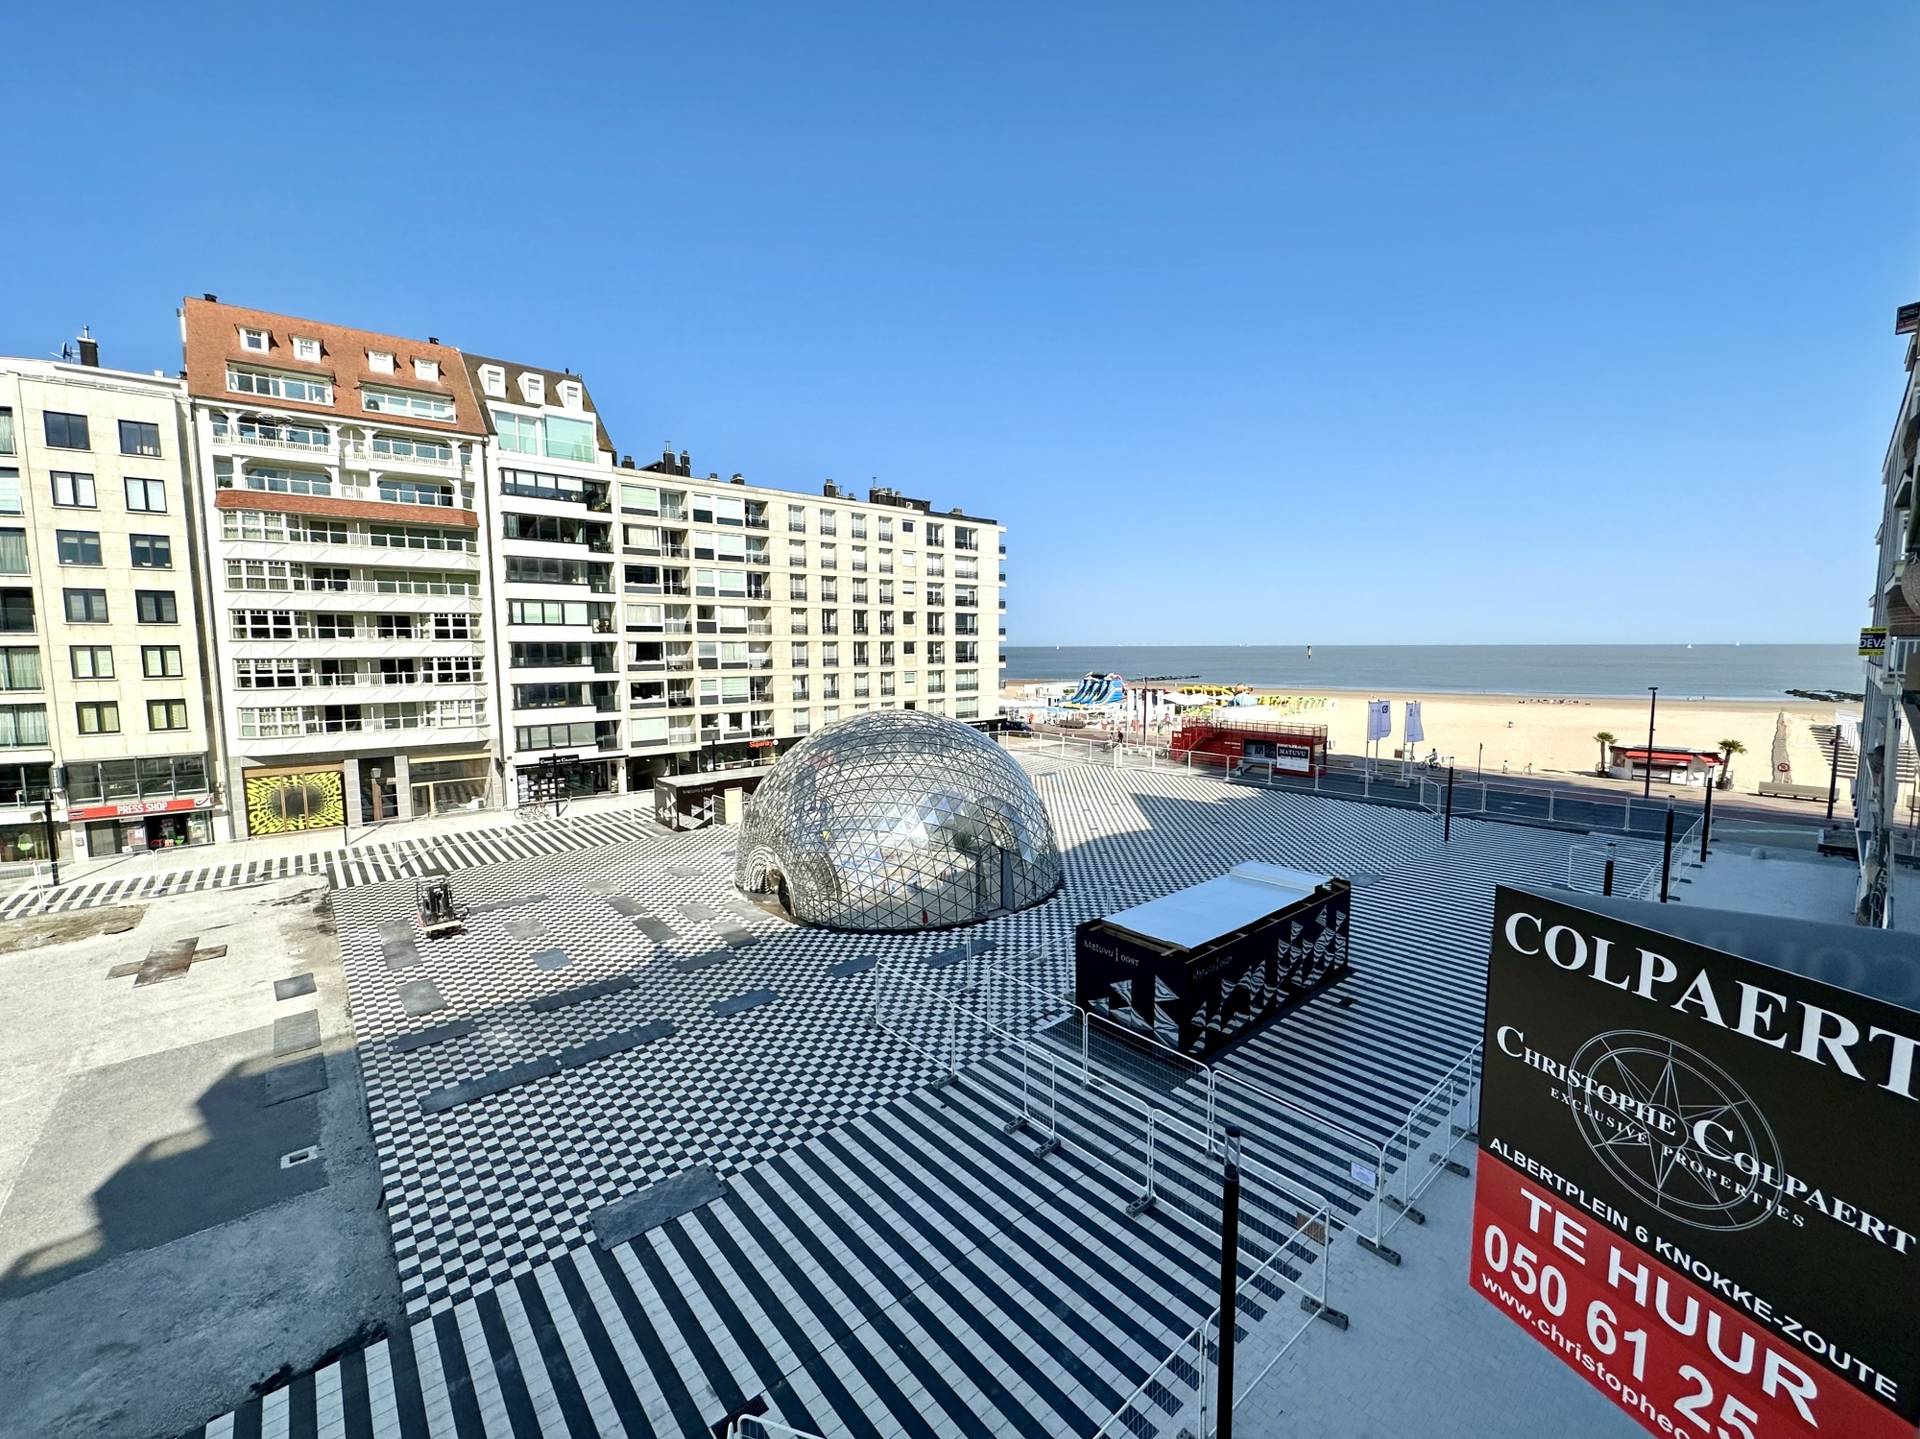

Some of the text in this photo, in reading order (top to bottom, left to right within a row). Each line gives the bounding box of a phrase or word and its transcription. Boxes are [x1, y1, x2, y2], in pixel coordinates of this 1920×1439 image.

[117, 801, 168, 814] PRESS SHOP
[1279, 748, 1307, 757] MATUVU
[1504, 911, 1920, 1102] COLPAERT
[1496, 1025, 1917, 1256] CHRISTOPHE COLPAERT
[1550, 1086, 1806, 1228] EXCLUSIVE PROPERTIES
[1484, 1225, 1759, 1439] 050 61 25
[1489, 1137, 1899, 1402] ALBERTPLEIN 6 KNOKKE-ZOUTE
[1520, 1188, 1819, 1428] TE HUUR
